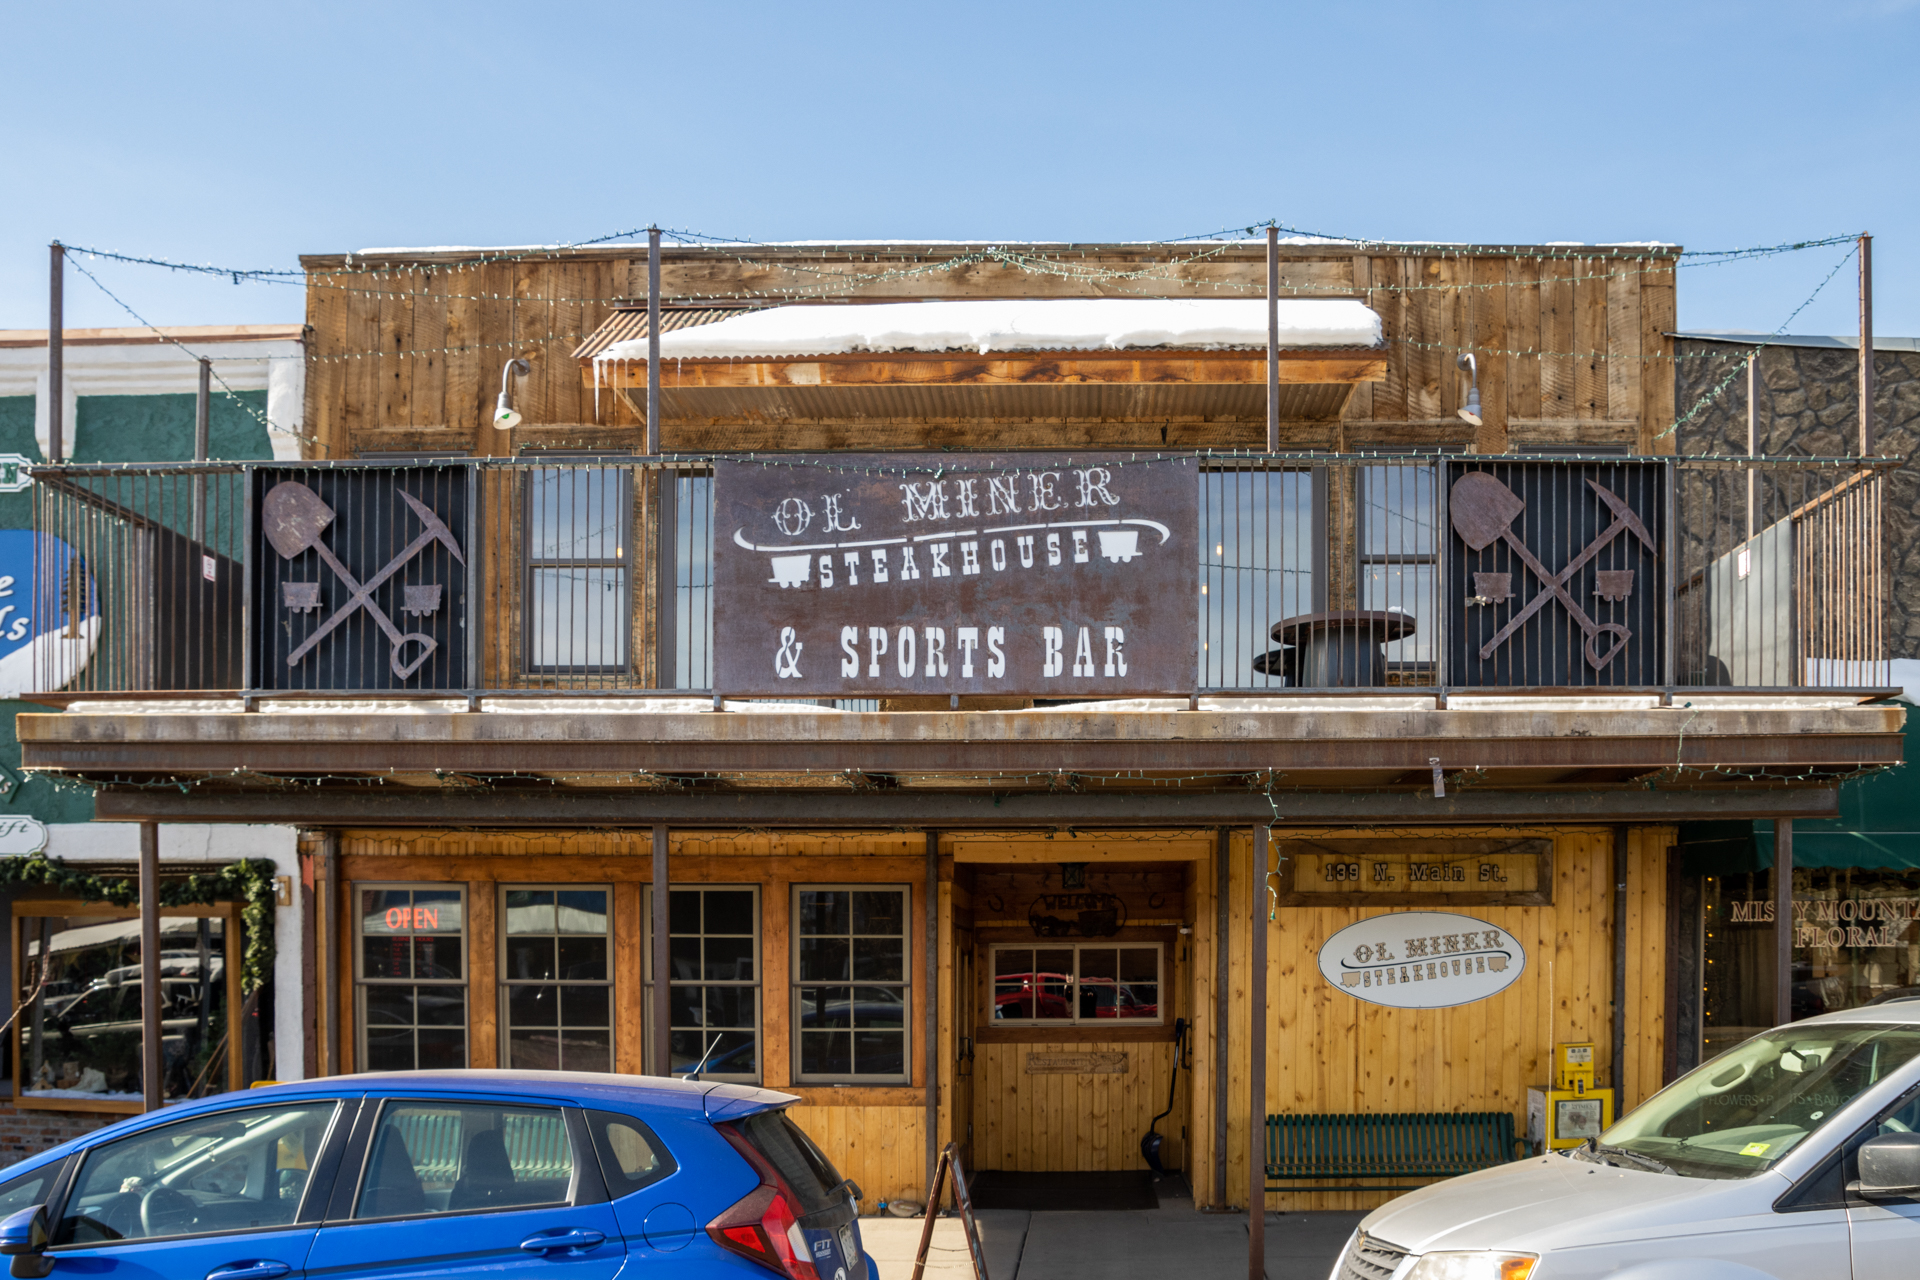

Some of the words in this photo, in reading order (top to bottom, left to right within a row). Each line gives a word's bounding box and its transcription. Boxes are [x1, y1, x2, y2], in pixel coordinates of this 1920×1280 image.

[771, 493, 861, 536] OL
[899, 467, 1120, 523] MINER
[818, 530, 1089, 589] STEAKHOUSE
[775, 626, 803, 679] &
[840, 626, 1006, 679] SPORTS
[1043, 626, 1128, 678] BAR
[1326, 863, 1359, 881] 139
[1374, 863, 1395, 881] N.
[1409, 863, 1465, 881] Main
[1479, 864, 1508, 882] St.
[1043, 893, 1117, 910] WELCOME
[1730, 900, 1811, 922] MISY
[385, 907, 438, 929] OPEN
[1353, 943, 1395, 963] OL
[1405, 930, 1504, 958] MINER
[1794, 925, 1896, 948] FLORAL
[1363, 957, 1485, 987] STEAKHOUSE
[1708, 1094, 1759, 1106] FLOWERS
[813, 1238, 832, 1251] FIT
